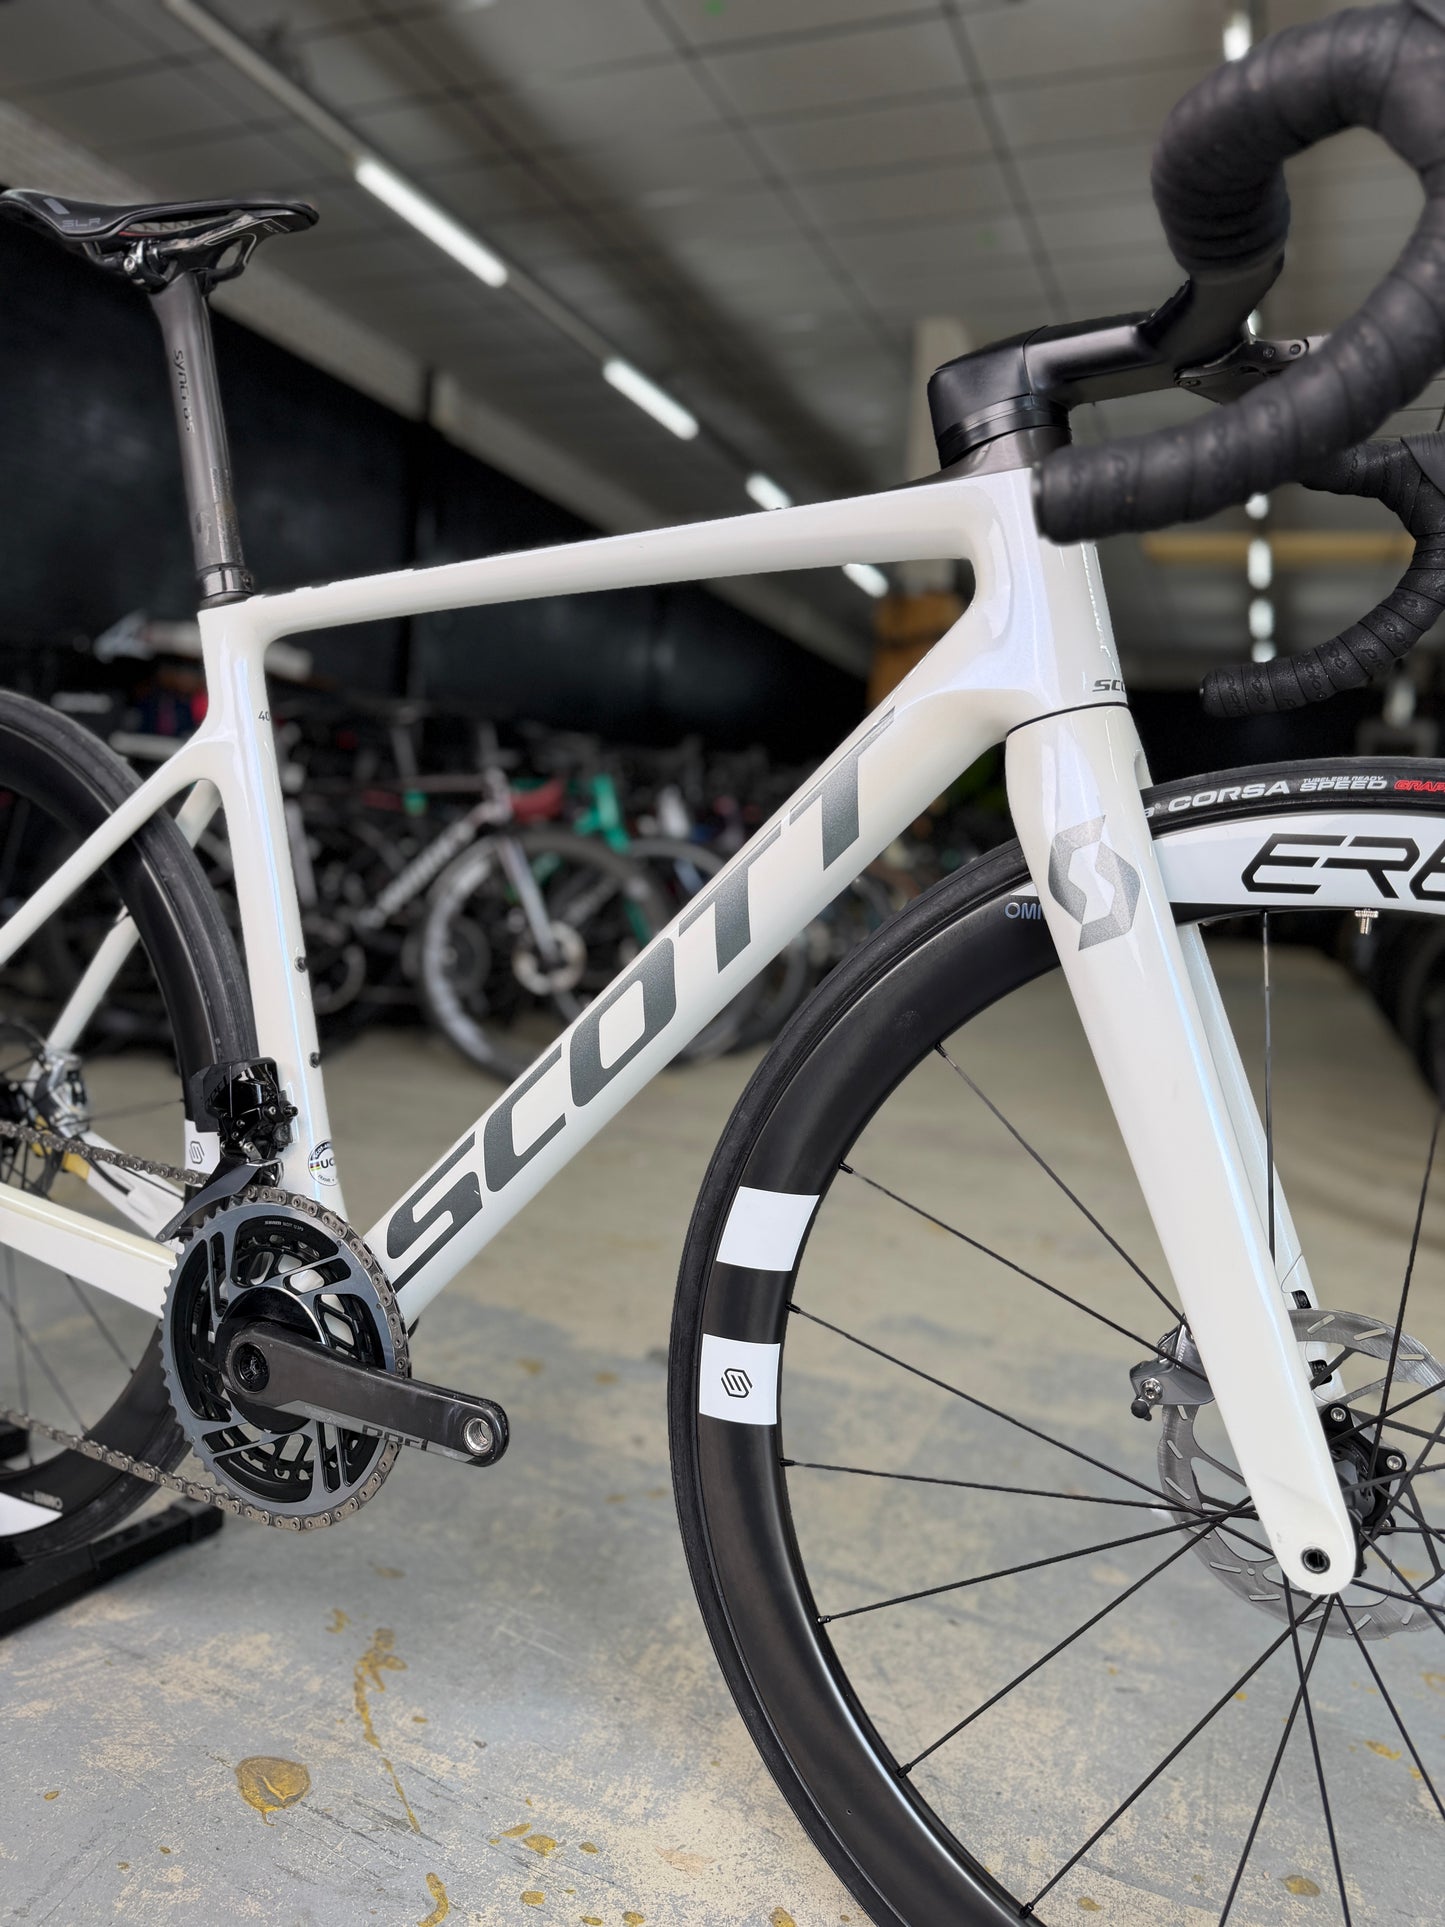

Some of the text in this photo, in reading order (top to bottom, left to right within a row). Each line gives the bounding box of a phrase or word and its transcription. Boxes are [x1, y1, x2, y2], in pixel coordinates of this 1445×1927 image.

[61, 217, 102, 229] SLR
[1091, 678, 1125, 693] SC
[1167, 779, 1291, 813] CORSA
[1299, 780, 1388, 792] SPEED
[387, 706, 896, 1292] SCOTT
